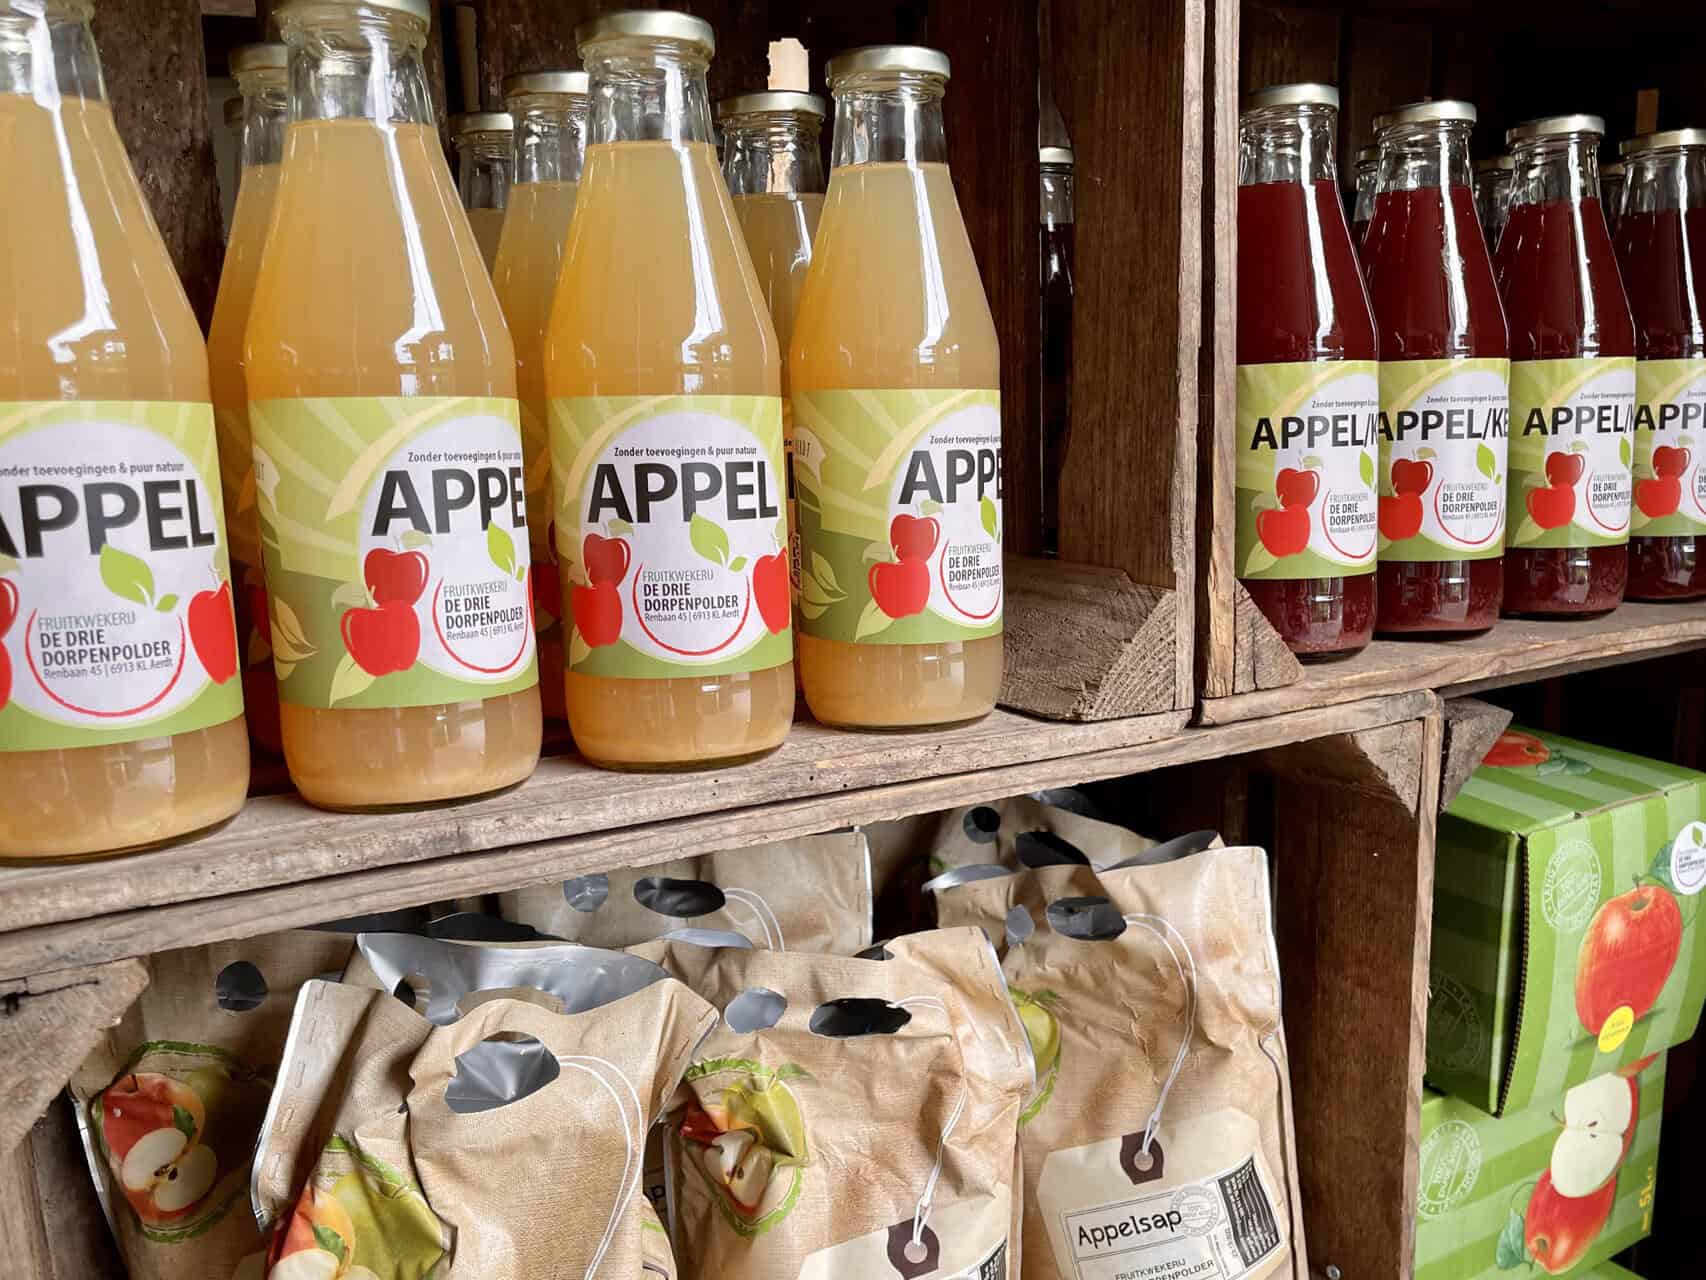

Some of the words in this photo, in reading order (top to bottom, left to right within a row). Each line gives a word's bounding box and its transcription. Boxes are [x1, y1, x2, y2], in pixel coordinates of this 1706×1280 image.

[408, 452, 442, 463] Zonder
[614, 447, 643, 457] Zonder
[646, 446, 706, 459] toevoegingen
[707, 446, 714, 456] &
[716, 447, 733, 457] puur
[33, 464, 117, 478] toevoegingen
[119, 462, 128, 474] &
[130, 463, 153, 476] puur
[587, 461, 778, 523] APPEL
[1443, 492, 1455, 502] DE
[1456, 491, 1476, 502] DRIE
[1330, 504, 1341, 514] DE
[1342, 502, 1359, 514] DRIE
[949, 557, 961, 568] DE
[962, 555, 981, 568] DRIE
[642, 569, 714, 582] FRUITKWEKERIJ
[644, 583, 659, 597] DE
[662, 583, 691, 597] DRIE
[445, 598, 462, 613] DE
[464, 596, 491, 611] DRIE
[644, 595, 739, 612] DORPENPOLDER
[38, 611, 137, 630] FRUITKWEKERIJ
[446, 606, 524, 630] DORPENPOLDER
[40, 632, 61, 648] DE
[66, 629, 105, 647] DRIE
[42, 640, 171, 667] DORPENPOLDER
[44, 668, 88, 680] Renbaan
[90, 664, 103, 676] 45
[110, 660, 135, 675] 6913
[1078, 1210, 1182, 1248] Appelsap
[1115, 1258, 1186, 1280] FRUITKWEKERIJ
